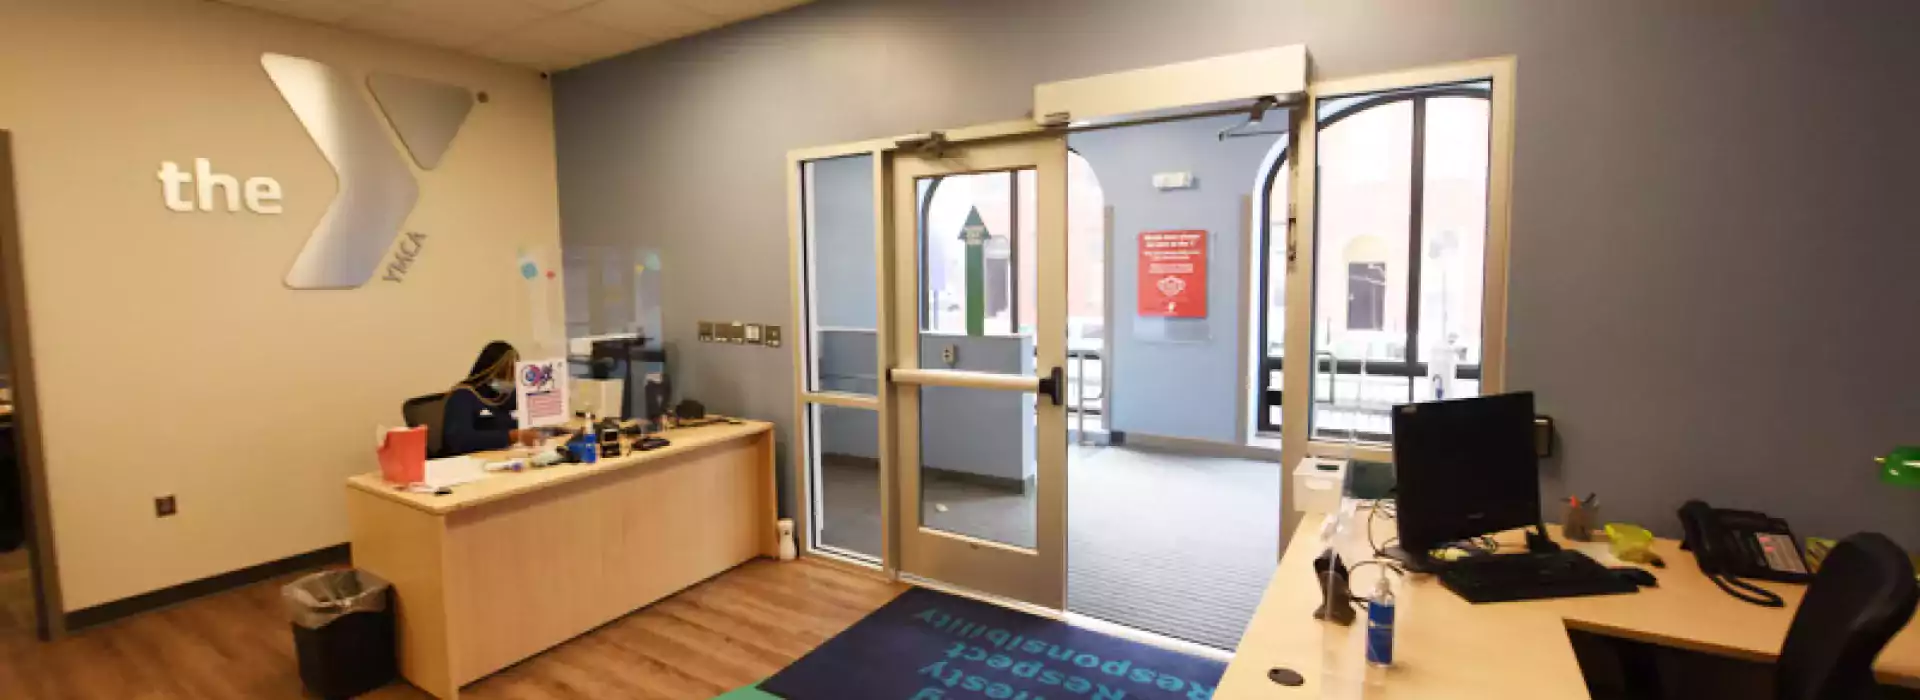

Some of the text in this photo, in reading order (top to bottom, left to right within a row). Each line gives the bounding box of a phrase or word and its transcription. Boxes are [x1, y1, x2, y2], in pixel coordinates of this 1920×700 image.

[157, 157, 283, 214] the
[382, 230, 427, 283] YMCA
[913, 609, 1213, 700] Responsibility
[943, 641, 1125, 700] Respect
